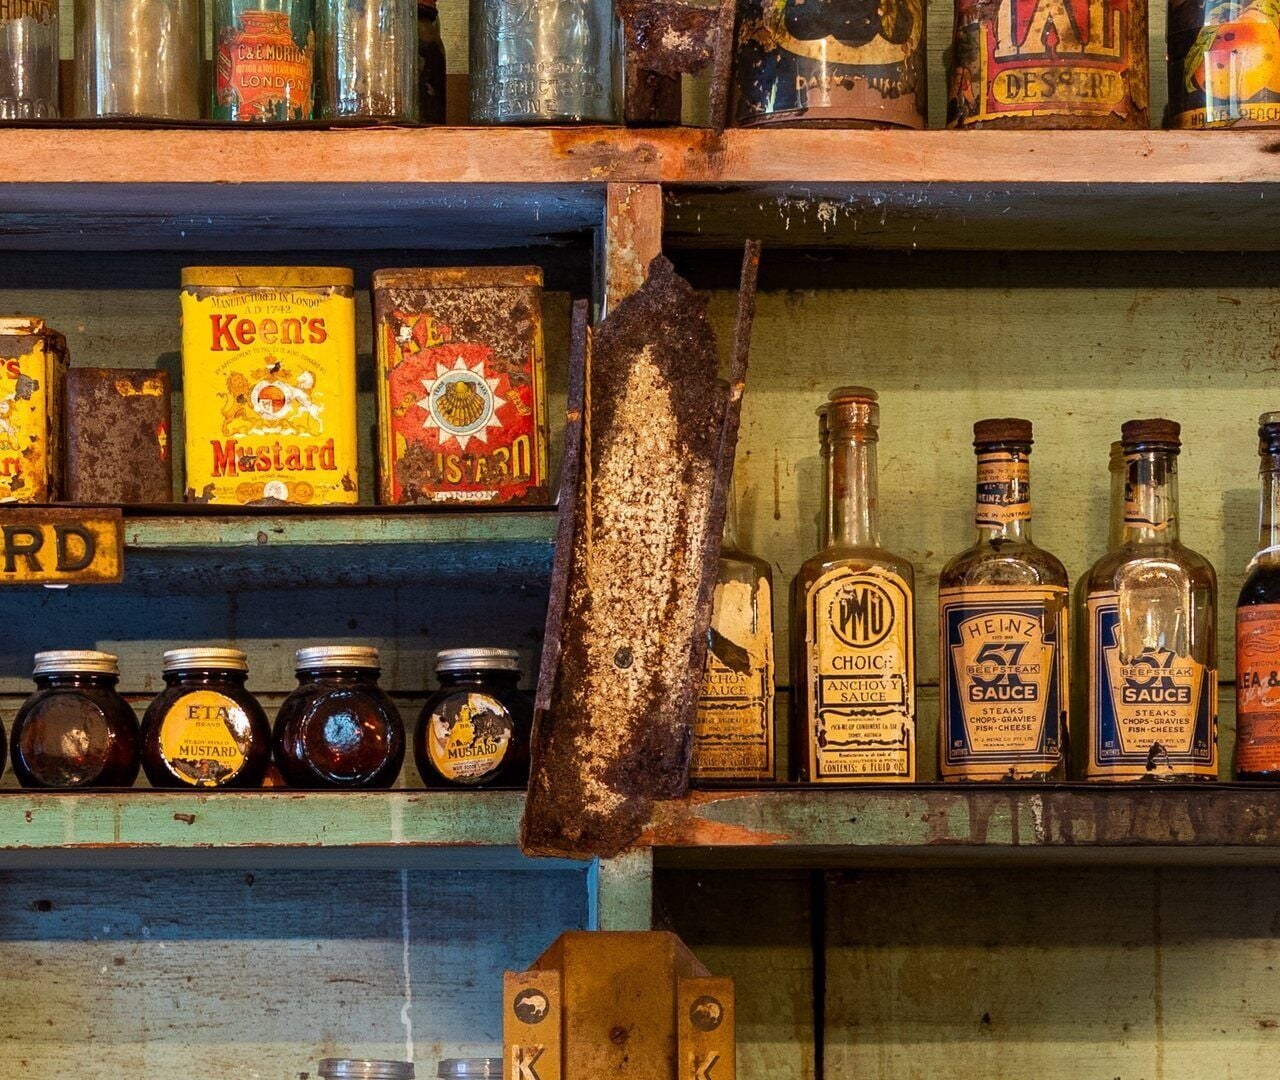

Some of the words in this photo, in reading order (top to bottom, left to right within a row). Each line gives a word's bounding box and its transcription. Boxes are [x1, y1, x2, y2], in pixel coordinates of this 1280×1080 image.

[241, 75, 304, 90] LONDON
[1004, 71, 1120, 99] DESSERT
[211, 293, 277, 308] MANUFACTURED
[266, 305, 292, 314] 1742
[209, 313, 328, 351] Keen's
[210, 438, 337, 477] Mustard
[968, 617, 1037, 640] HEINZ
[968, 665, 1039, 673] BEEFSTEAK
[828, 680, 901, 691] ANCHOVY
[1238, 672, 1260, 690] LEA
[840, 692, 887, 702] SAUCE
[971, 684, 1036, 699] SAUCE
[982, 707, 1024, 715] STEAKS
[178, 744, 237, 758] MUSTARD
